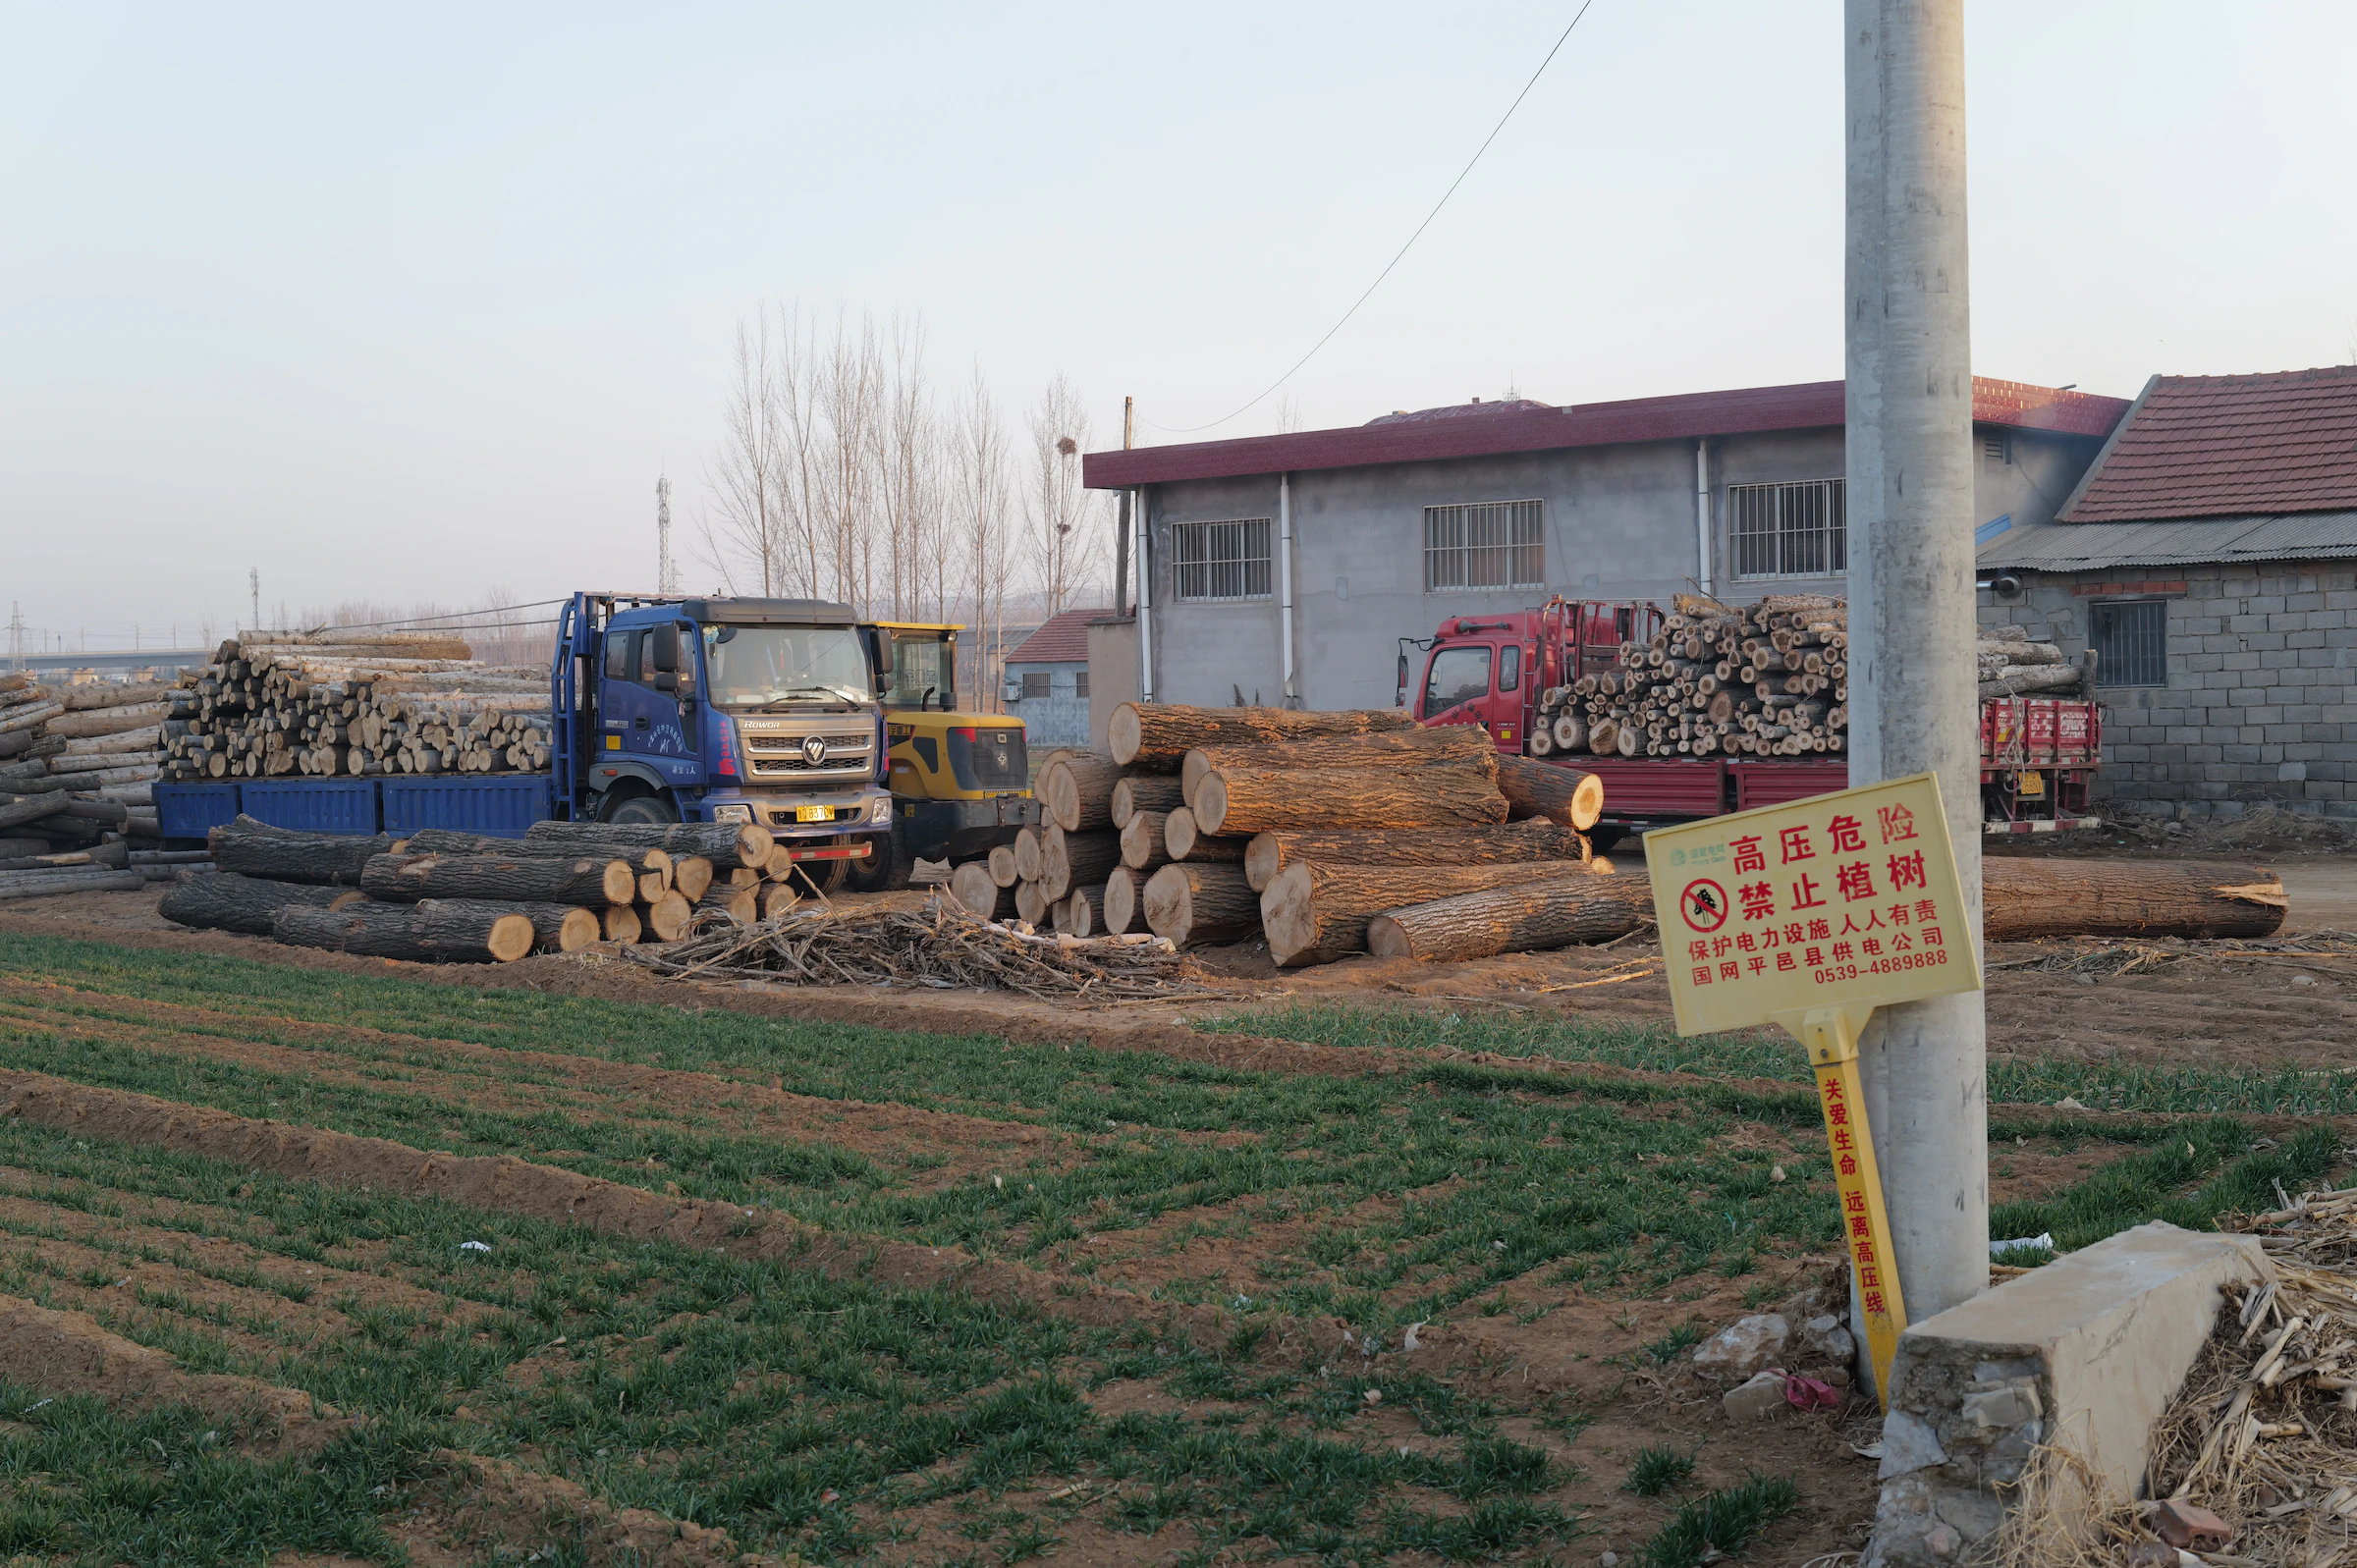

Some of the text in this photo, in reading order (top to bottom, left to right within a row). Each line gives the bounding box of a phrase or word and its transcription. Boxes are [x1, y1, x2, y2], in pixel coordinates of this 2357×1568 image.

[1728, 803, 1919, 875] 高压危险
[1738, 849, 1927, 921] 禁止植树
[1692, 927, 1944, 986] 国网平邑县供电公司
[1815, 949, 1947, 984] 0539-4889888
[1825, 1077, 1856, 1176] 关爱生命
[1845, 1190, 1886, 1314] 远离高压线
